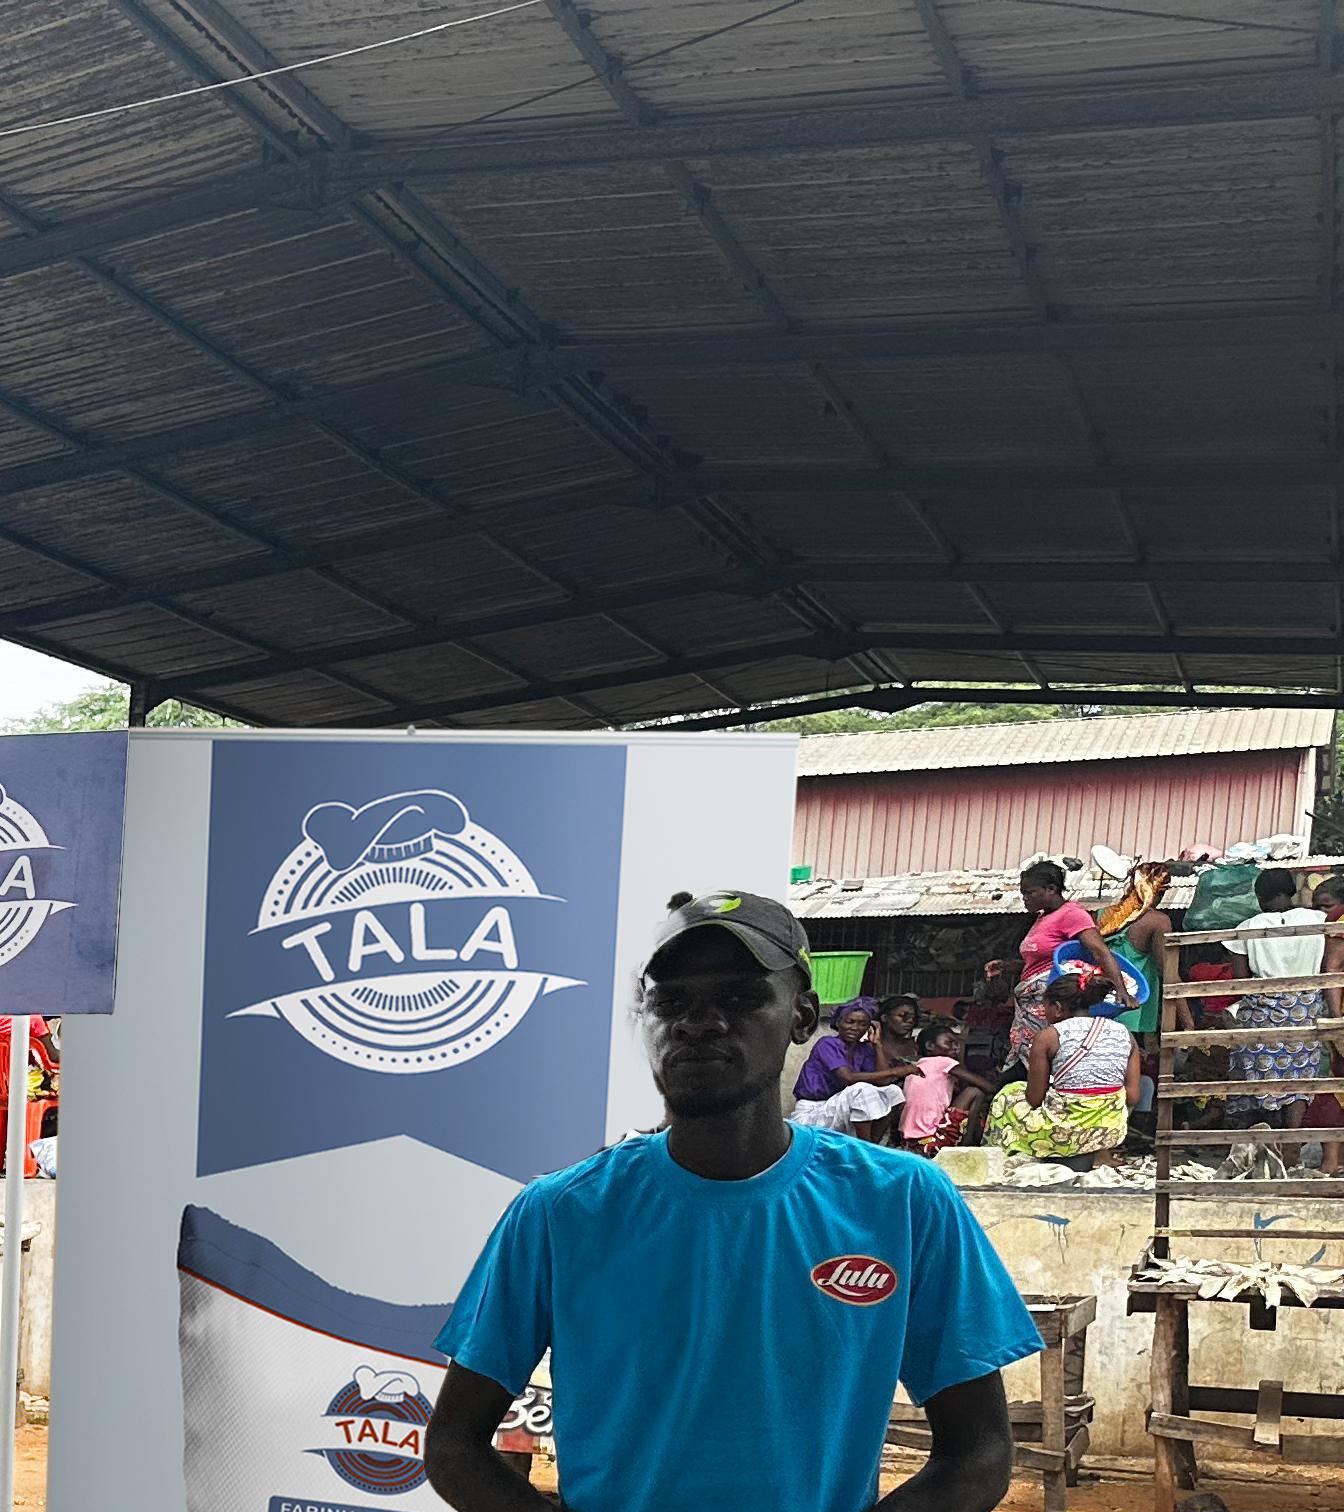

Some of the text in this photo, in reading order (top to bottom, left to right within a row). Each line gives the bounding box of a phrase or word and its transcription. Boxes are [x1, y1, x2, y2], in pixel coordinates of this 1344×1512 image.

[281, 902, 519, 982] TALA
[816, 1260, 890, 1291] Lulu
[334, 1417, 422, 1455] TALA
